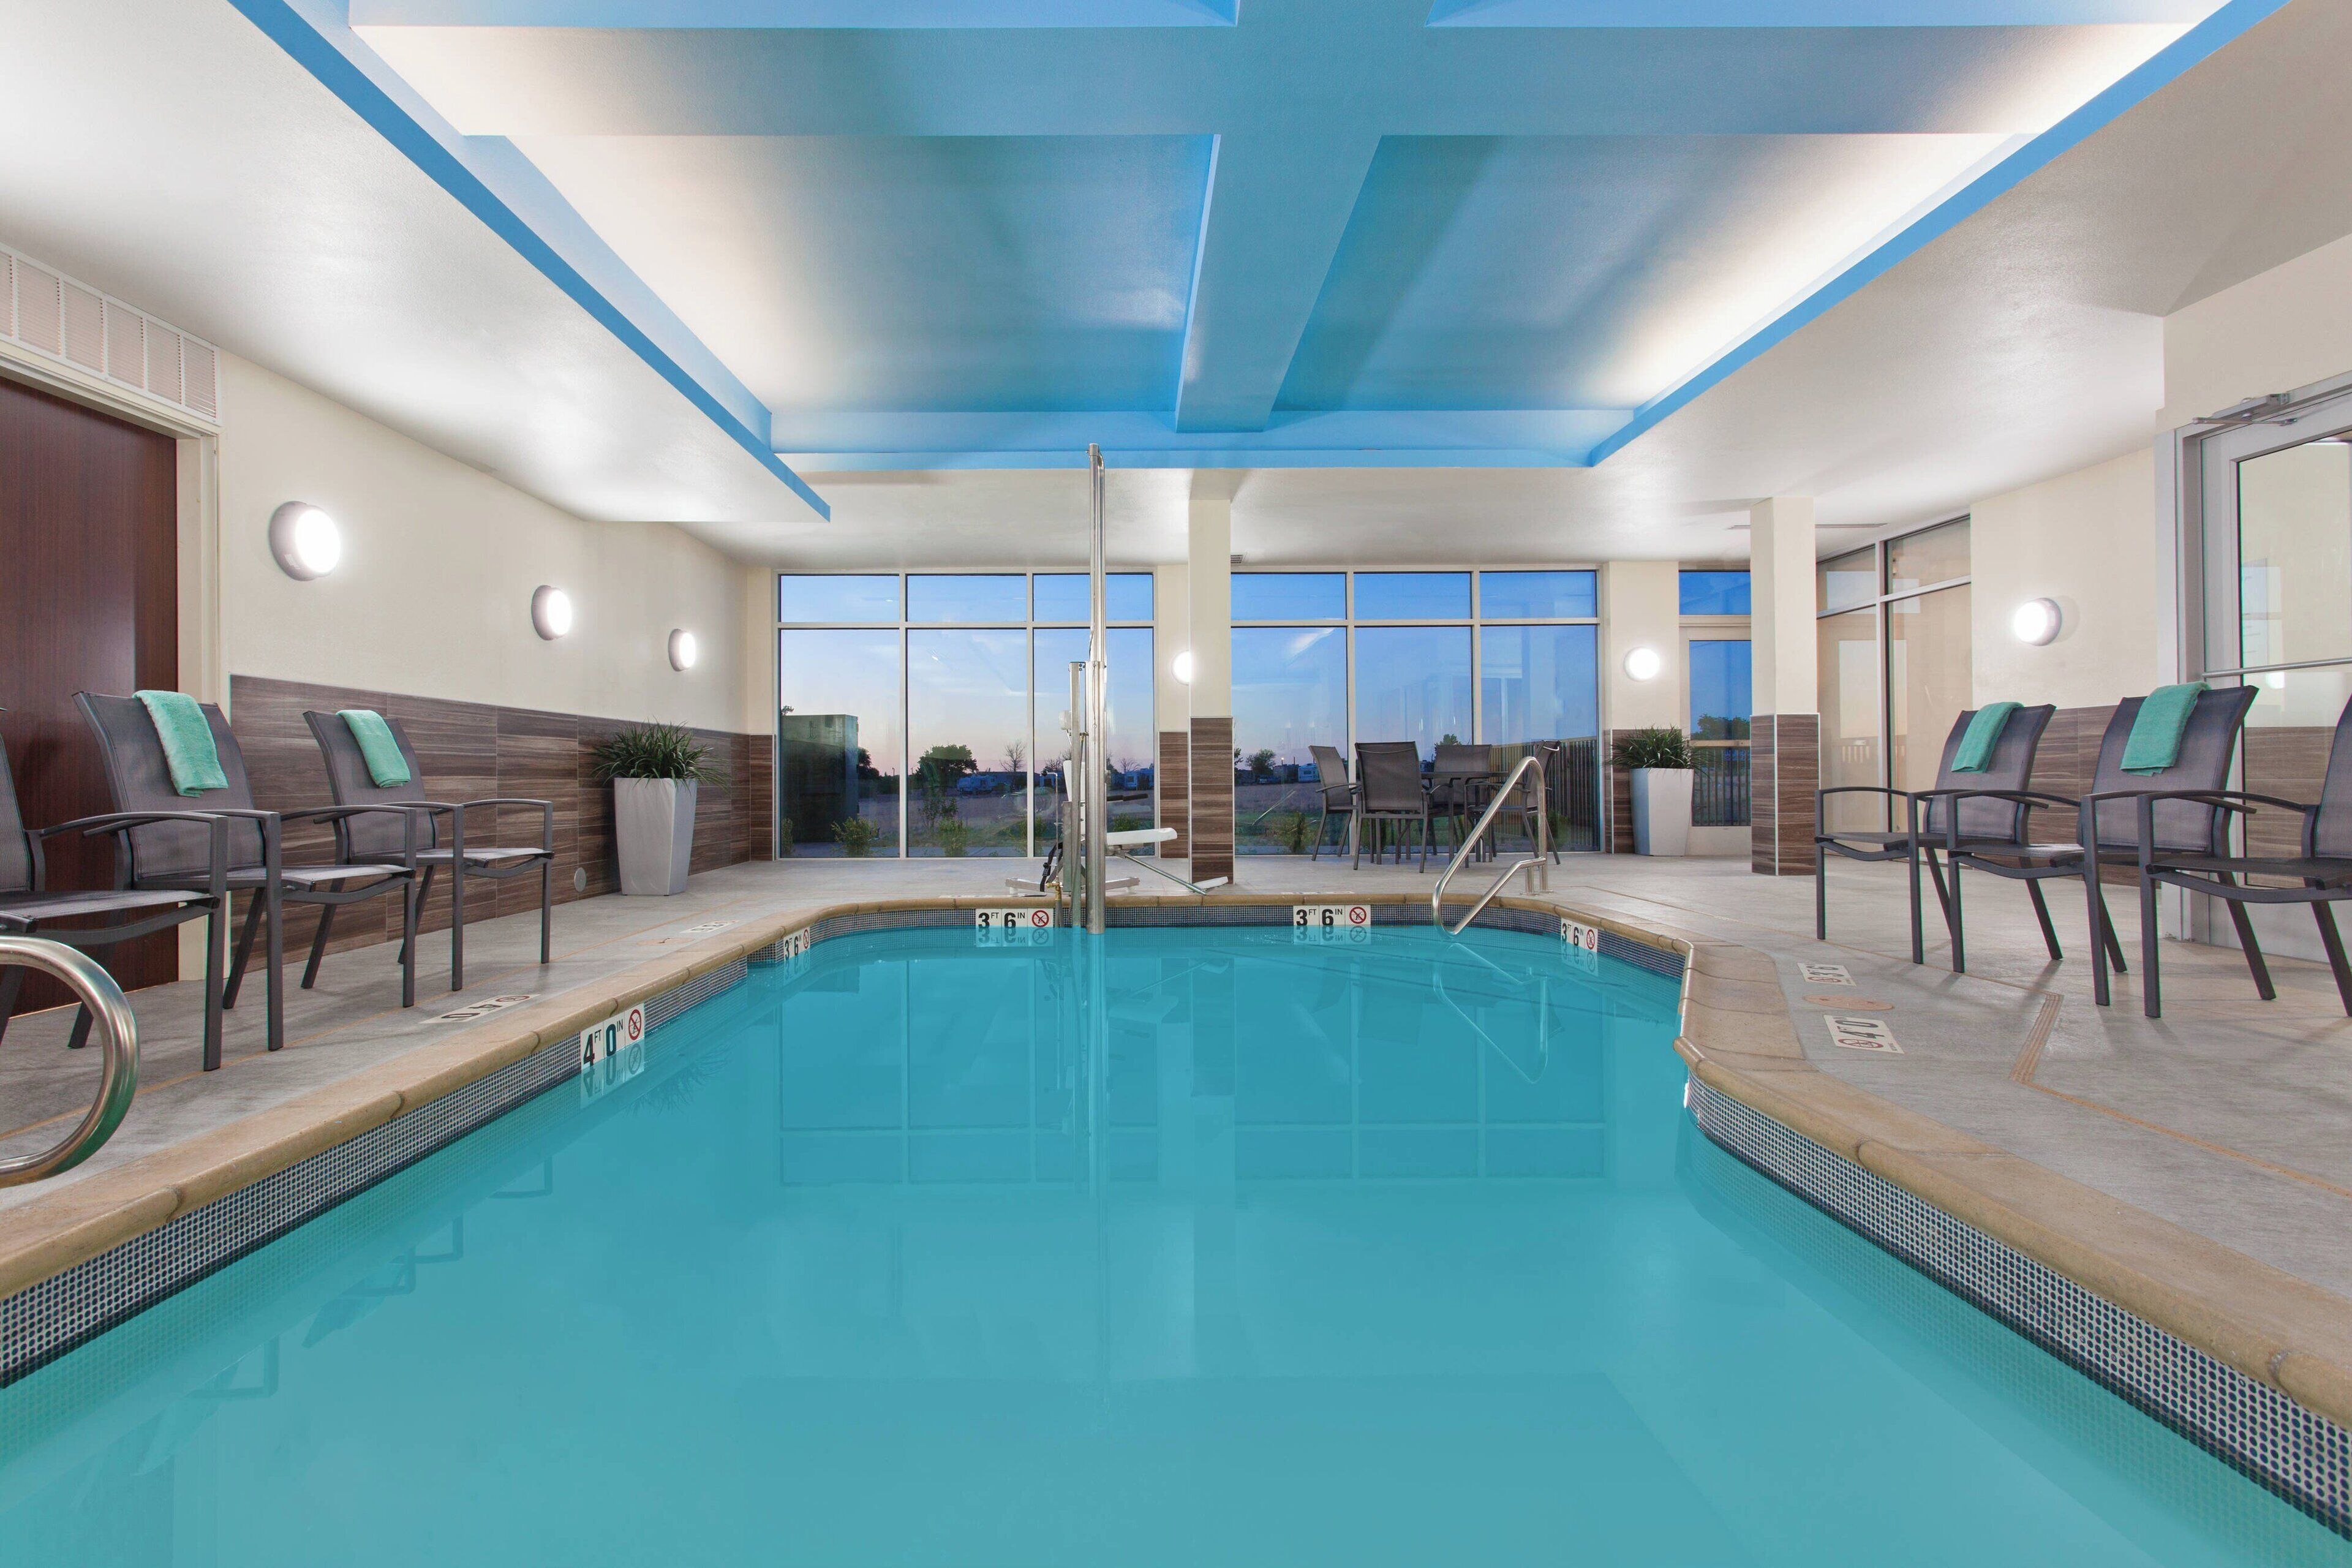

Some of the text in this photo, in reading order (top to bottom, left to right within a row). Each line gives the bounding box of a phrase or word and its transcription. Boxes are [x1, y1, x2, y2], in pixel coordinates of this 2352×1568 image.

[978, 913, 990, 928] 3
[1005, 913, 1016, 928] 6
[1296, 910, 1307, 925] 3
[1322, 909, 1333, 925] 6
[1562, 923, 1567, 941] 3
[1574, 927, 1579, 946] 6
[785, 940, 790, 960] 3
[794, 936, 799, 956] 6
[583, 1019, 624, 1067] 4 FT 0 IN
[1839, 1030, 1885, 1039] 4
